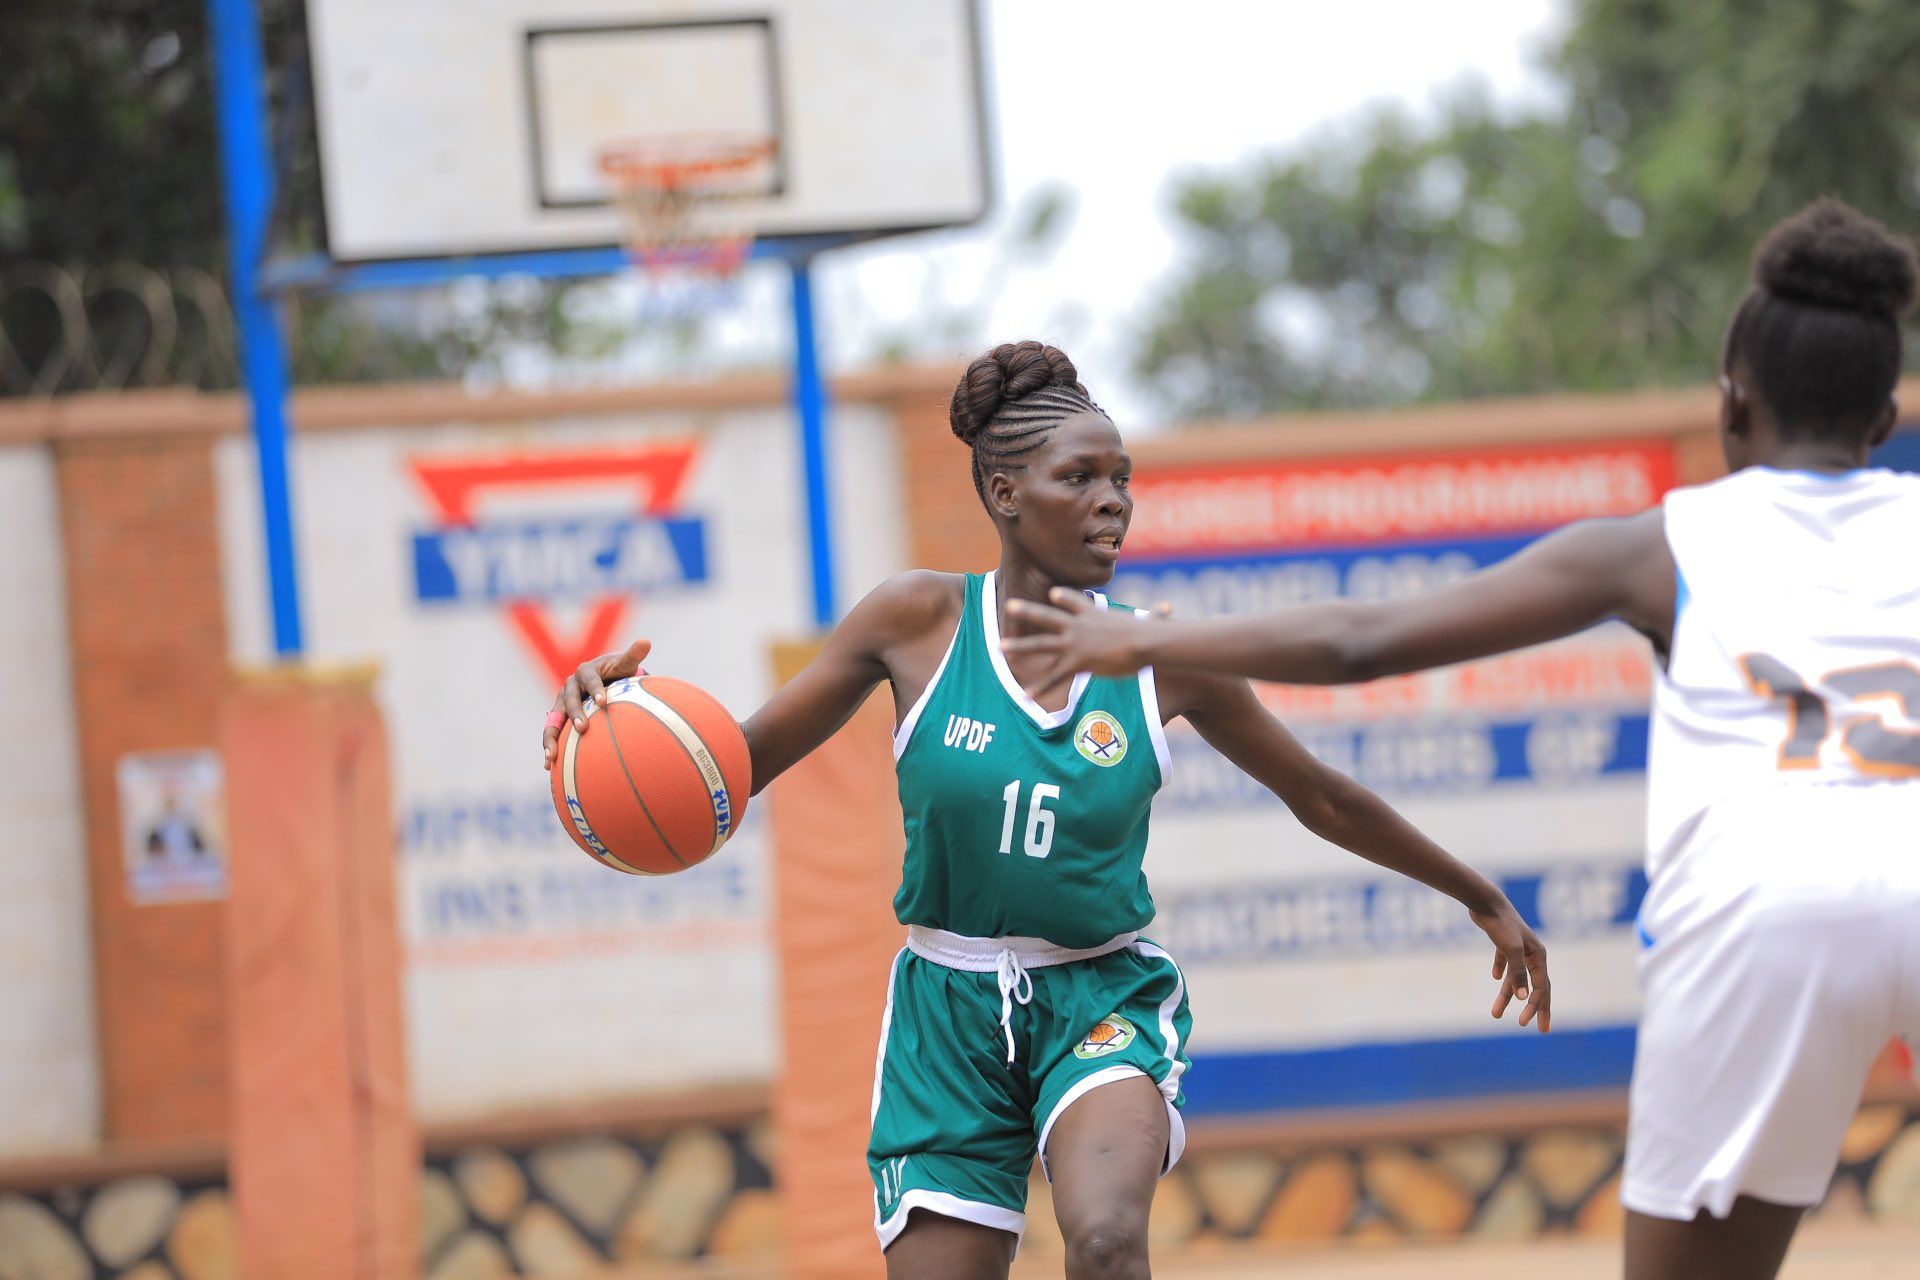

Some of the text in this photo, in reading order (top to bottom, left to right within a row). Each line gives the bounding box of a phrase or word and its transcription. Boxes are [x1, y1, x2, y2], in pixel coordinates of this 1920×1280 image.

[437, 520, 688, 601] YMCA
[943, 714, 996, 754] UPDF
[998, 779, 1061, 859] 16
